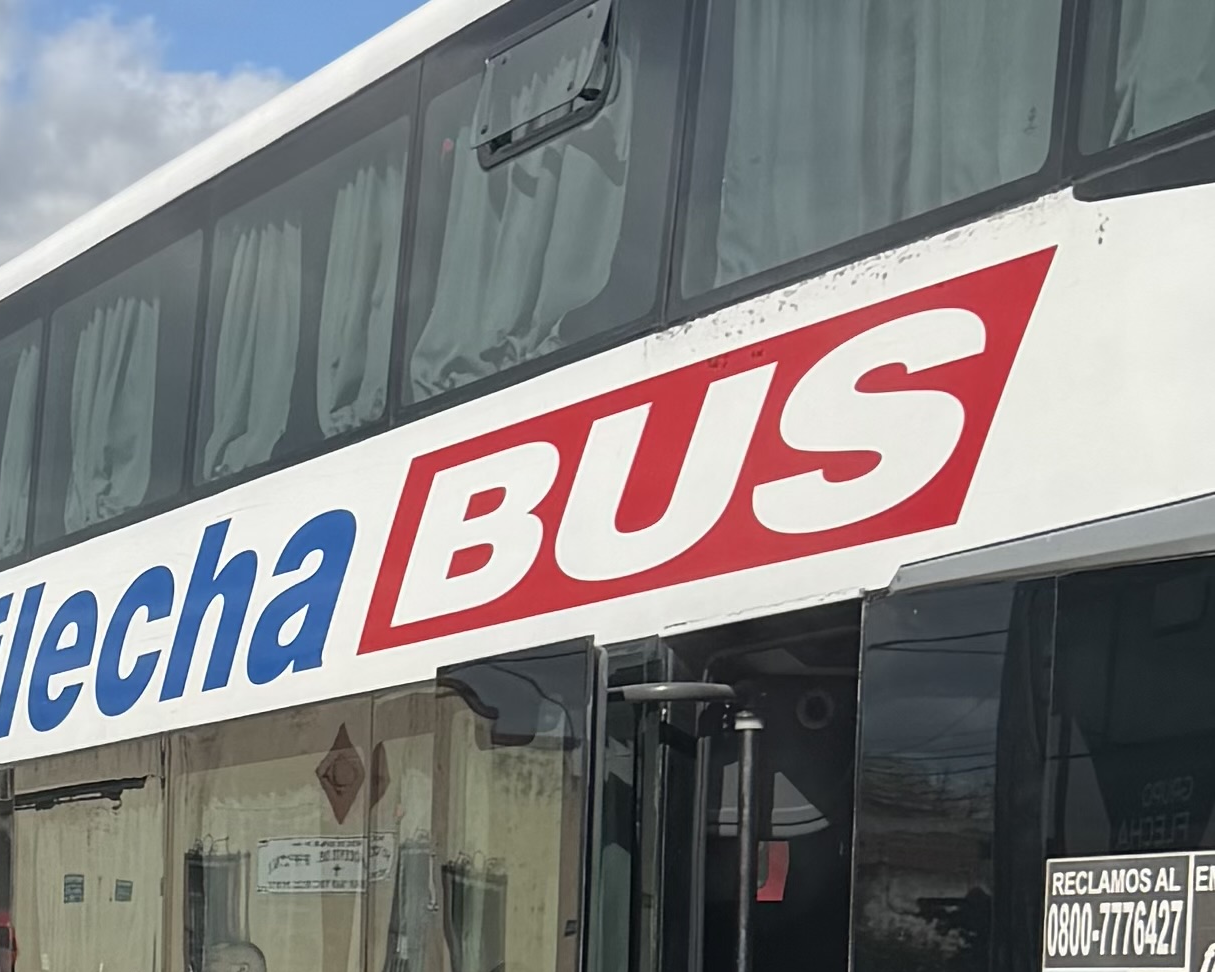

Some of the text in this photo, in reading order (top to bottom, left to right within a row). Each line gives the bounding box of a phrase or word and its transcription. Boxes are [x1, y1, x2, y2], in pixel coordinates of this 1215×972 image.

[390, 307, 988, 629] BUS
[1052, 867, 1181, 895] RECLAMOS AL
[1048, 900, 1184, 956] 0800-7776427
